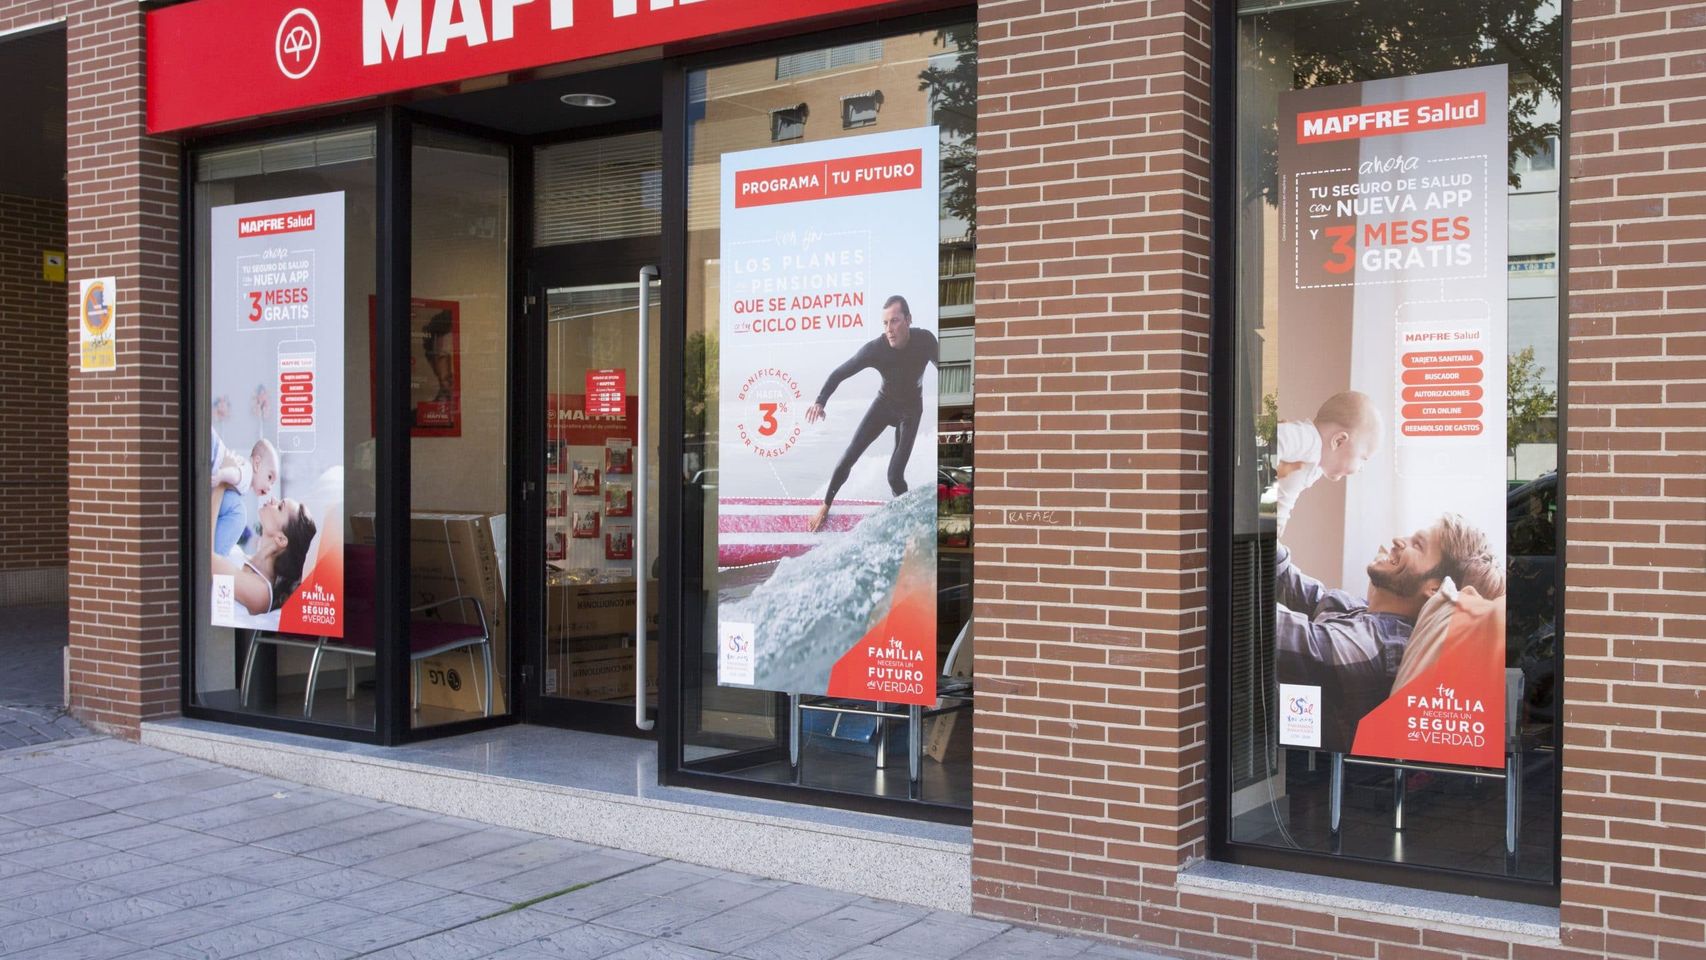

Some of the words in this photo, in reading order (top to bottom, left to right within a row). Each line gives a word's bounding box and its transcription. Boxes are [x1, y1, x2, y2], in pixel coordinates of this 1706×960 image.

[1303, 108, 1410, 137] MAPFRE
[1417, 99, 1479, 124] Salud
[1358, 155, 1420, 175] ahora
[742, 174, 820, 196] PROGRAMA
[831, 170, 850, 185] TU
[855, 163, 915, 182] FUTURO
[1309, 186, 1328, 199] TU
[1332, 182, 1392, 197] SEGURO
[1397, 178, 1417, 191] DE
[1421, 173, 1473, 189] SALUD
[1309, 203, 1331, 218] con
[1336, 194, 1418, 218] NUEVA
[1424, 189, 1473, 210] APP
[241, 217, 285, 234] MAPFRE
[287, 213, 313, 228] Salud
[1309, 229, 1319, 240] Y
[1322, 225, 1355, 274] 3
[1364, 216, 1471, 248] MESES
[735, 256, 771, 274] LOS
[783, 249, 865, 270] PLANES
[1362, 243, 1473, 272] GRATIS
[253, 273, 288, 286] NUEVA
[289, 270, 309, 282] APP
[751, 271, 865, 293] PENSIONES
[249, 291, 262, 322] 3
[265, 287, 309, 305] MESES
[734, 299, 764, 314] QUE
[769, 297, 786, 312] SE
[791, 292, 864, 311] ADAPTAN
[264, 305, 309, 321] GRATIS
[752, 317, 797, 333] CICLO
[802, 316, 821, 330] DE
[826, 313, 864, 329] VIDA
[1405, 332, 1451, 342] MAPFRE
[1454, 330, 1480, 340] Salud
[738, 423, 752, 447] POR
[753, 427, 801, 458] TRASLADO
[1008, 511, 1060, 524] RAFAEL
[302, 591, 336, 602] FAMILIA
[302, 605, 336, 616] SEGURO
[889, 636, 903, 650] tu
[868, 646, 924, 662] FAMILIA
[429, 669, 446, 686] LG
[868, 667, 923, 681] FUTURO
[876, 680, 924, 695] VERDAD
[1436, 683, 1455, 700] tu
[1407, 695, 1484, 713] FAMILIA
[1423, 710, 1458, 718] NECESITA
[1407, 717, 1485, 734] SEGURO
[1407, 730, 1420, 741] de
[1420, 731, 1485, 748] VERDAD
